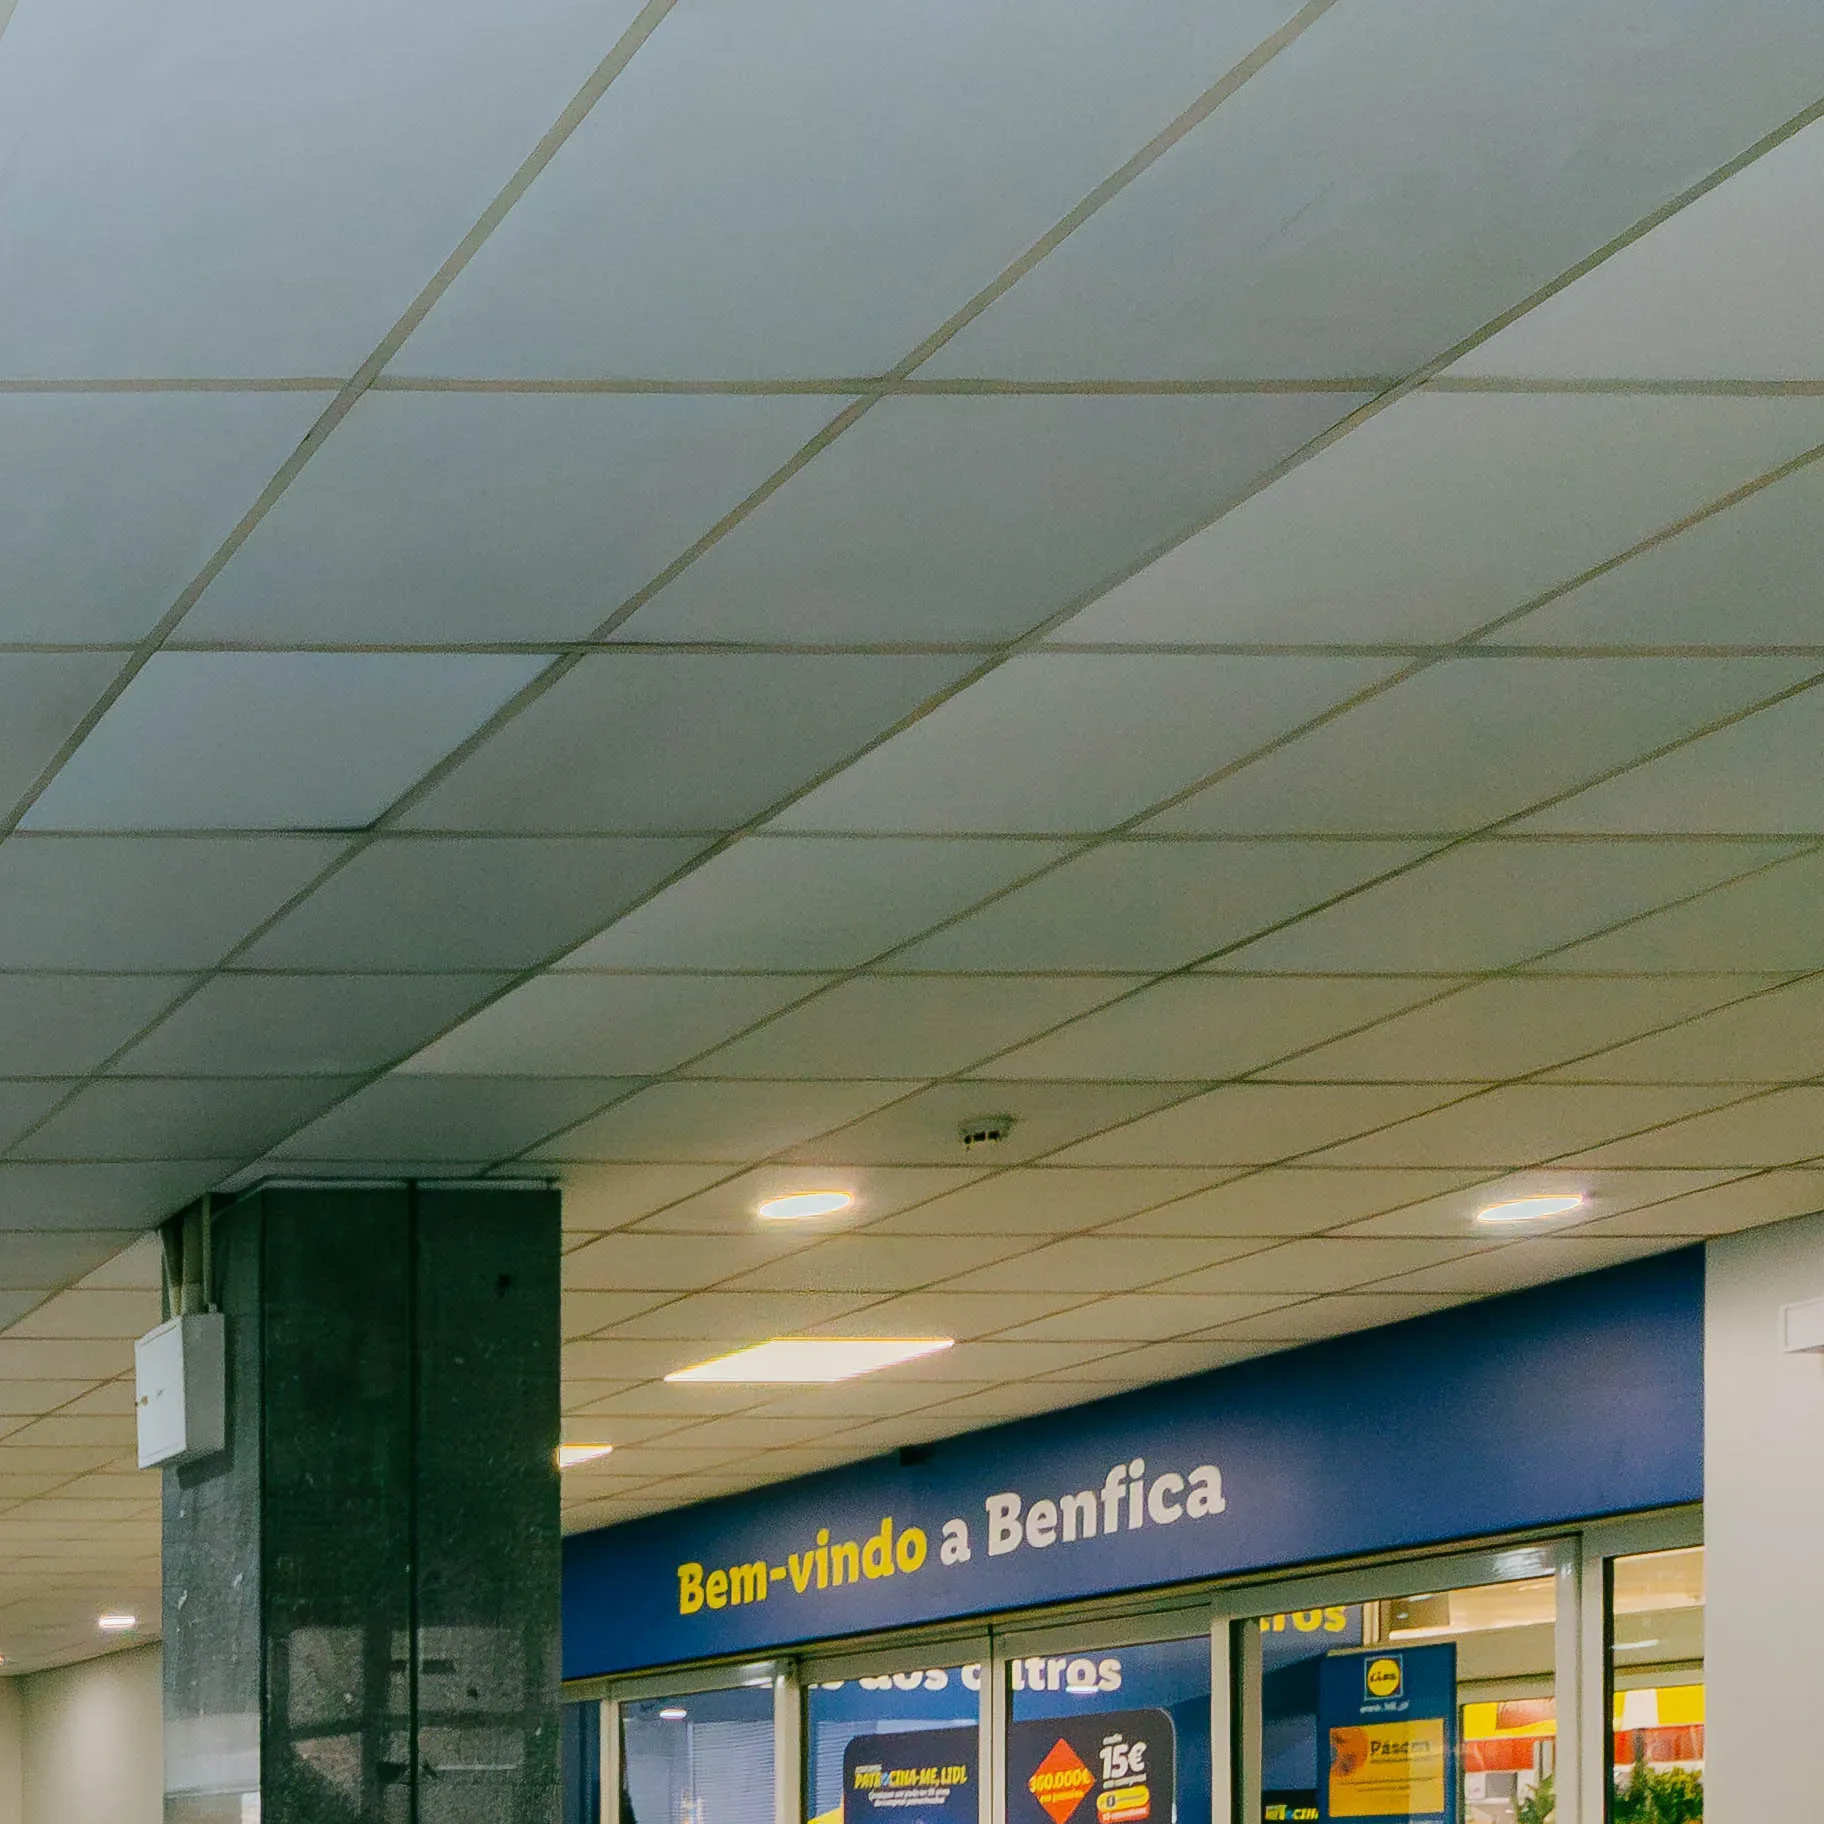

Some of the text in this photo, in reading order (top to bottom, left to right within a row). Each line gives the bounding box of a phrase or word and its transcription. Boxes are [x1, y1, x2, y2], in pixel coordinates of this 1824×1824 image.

[677, 1457, 1226, 1615] Bem-vindo a Benfica
[941, 1765, 968, 1785] LIDL
[1099, 1741, 1147, 1780] 15€
